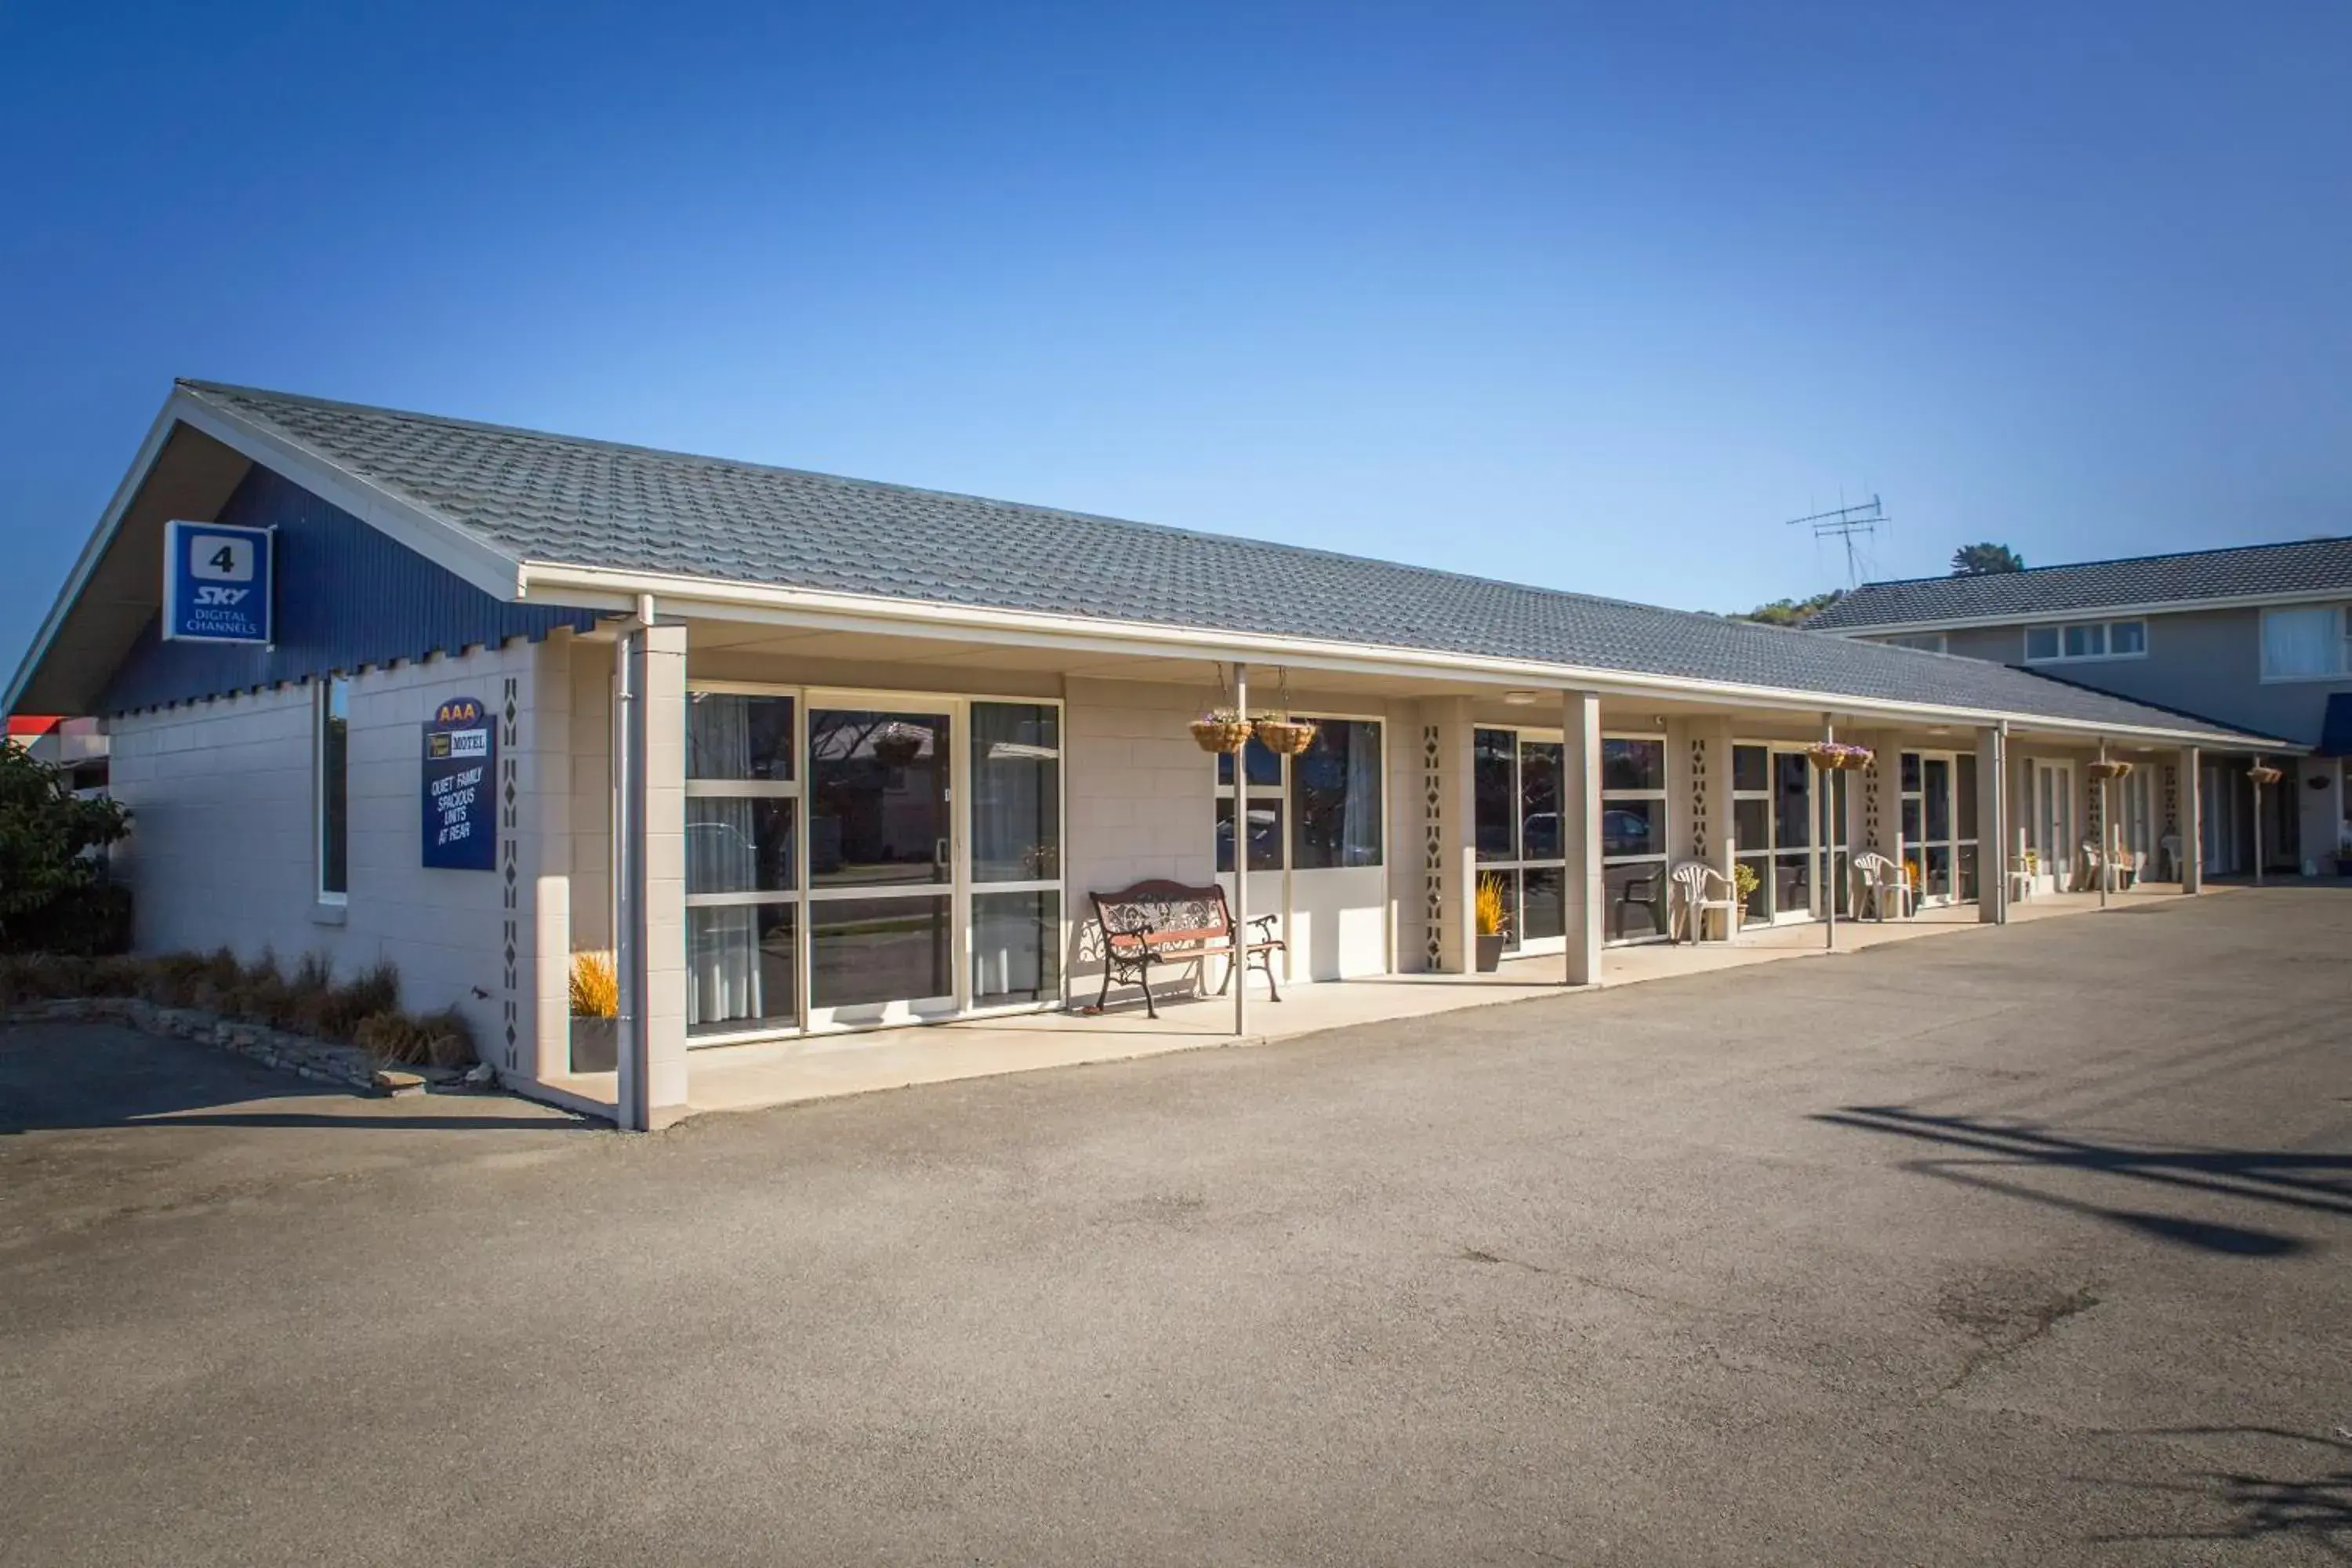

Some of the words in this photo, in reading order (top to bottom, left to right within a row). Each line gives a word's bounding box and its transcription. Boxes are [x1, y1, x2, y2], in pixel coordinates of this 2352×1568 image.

[209, 546, 234, 573] 4
[193, 586, 250, 604] SKY
[196, 609, 246, 622] DIGITAL
[186, 619, 257, 633] CHANNELS
[440, 703, 475, 721] AAA
[452, 735, 485, 750] MOTEL
[431, 775, 454, 796] QUIET
[456, 765, 483, 789] FAMILY
[437, 786, 475, 812] SPACIOUS
[445, 805, 466, 826] UNITS
[439, 828, 448, 846] AT
[449, 821, 470, 841] REAR
